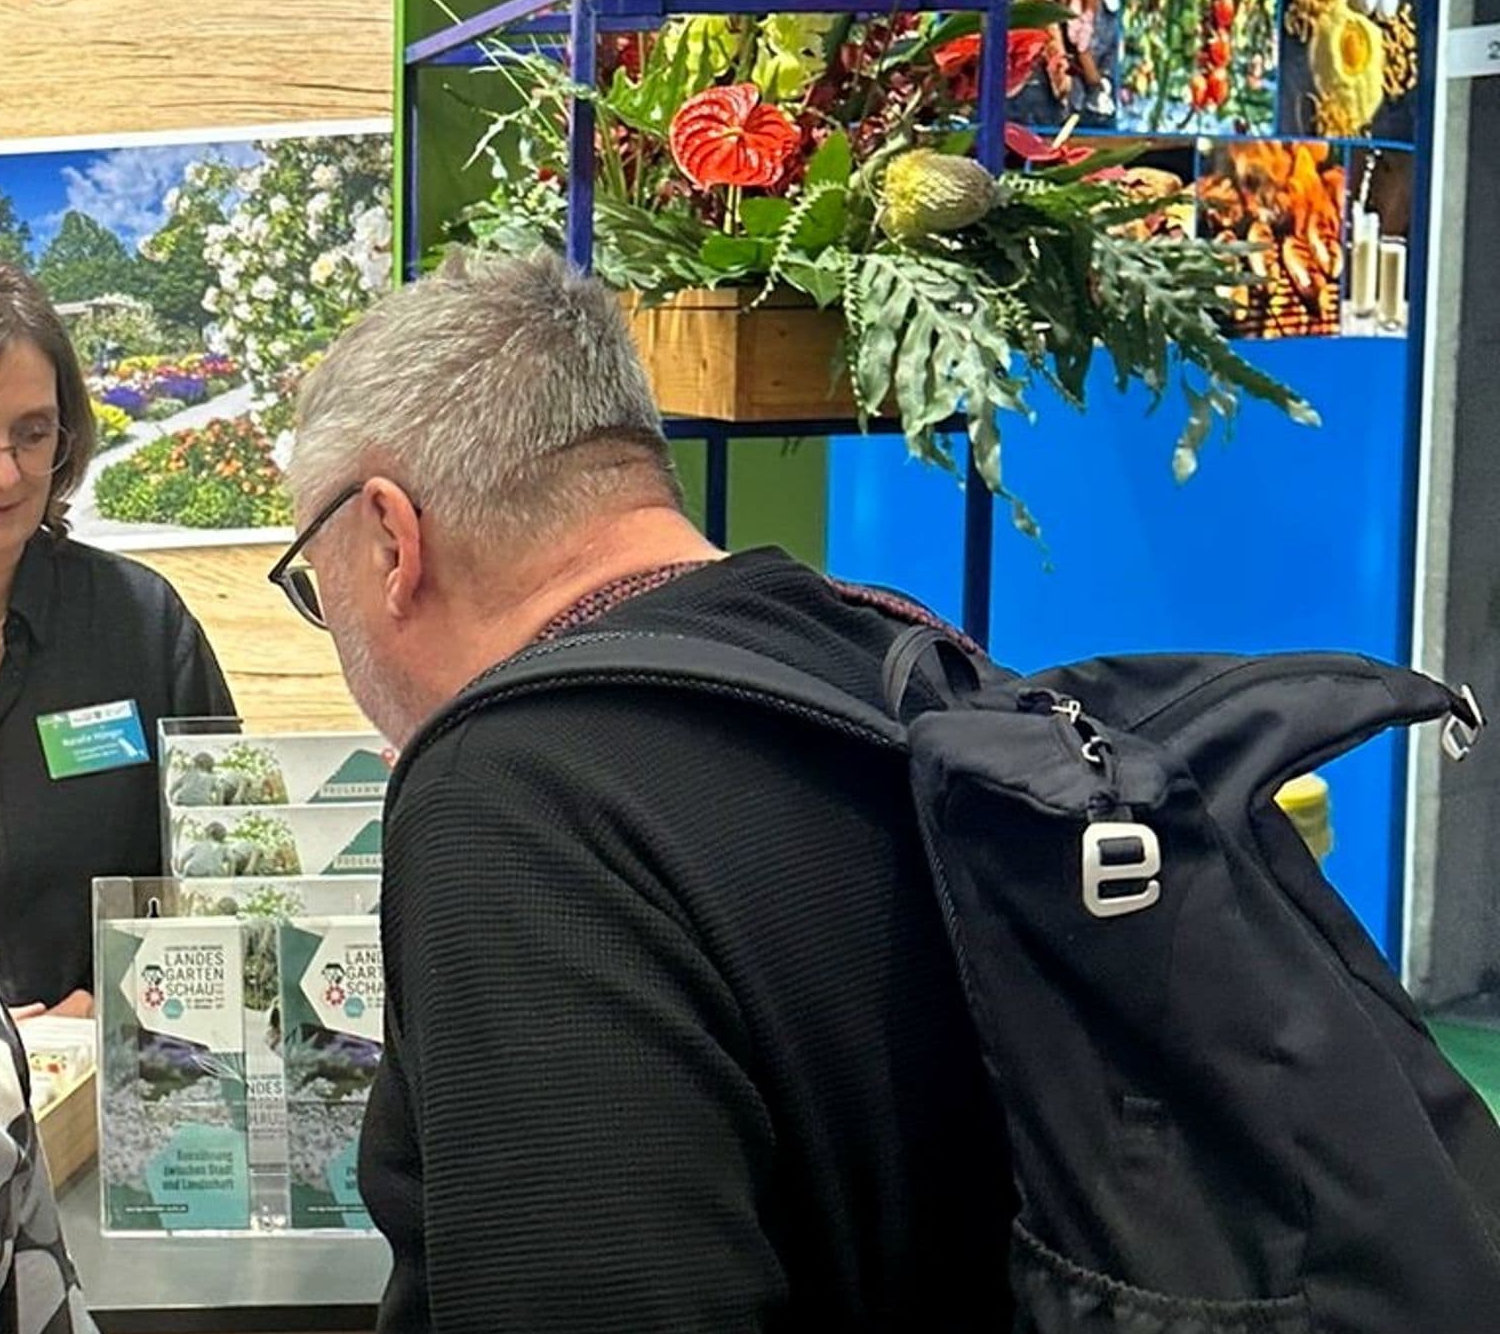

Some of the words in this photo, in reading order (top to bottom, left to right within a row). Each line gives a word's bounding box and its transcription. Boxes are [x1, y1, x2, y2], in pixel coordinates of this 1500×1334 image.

[164, 952, 224, 966] LANDES
[165, 968, 224, 982] GARTEN
[165, 983, 215, 996] SCHAU
